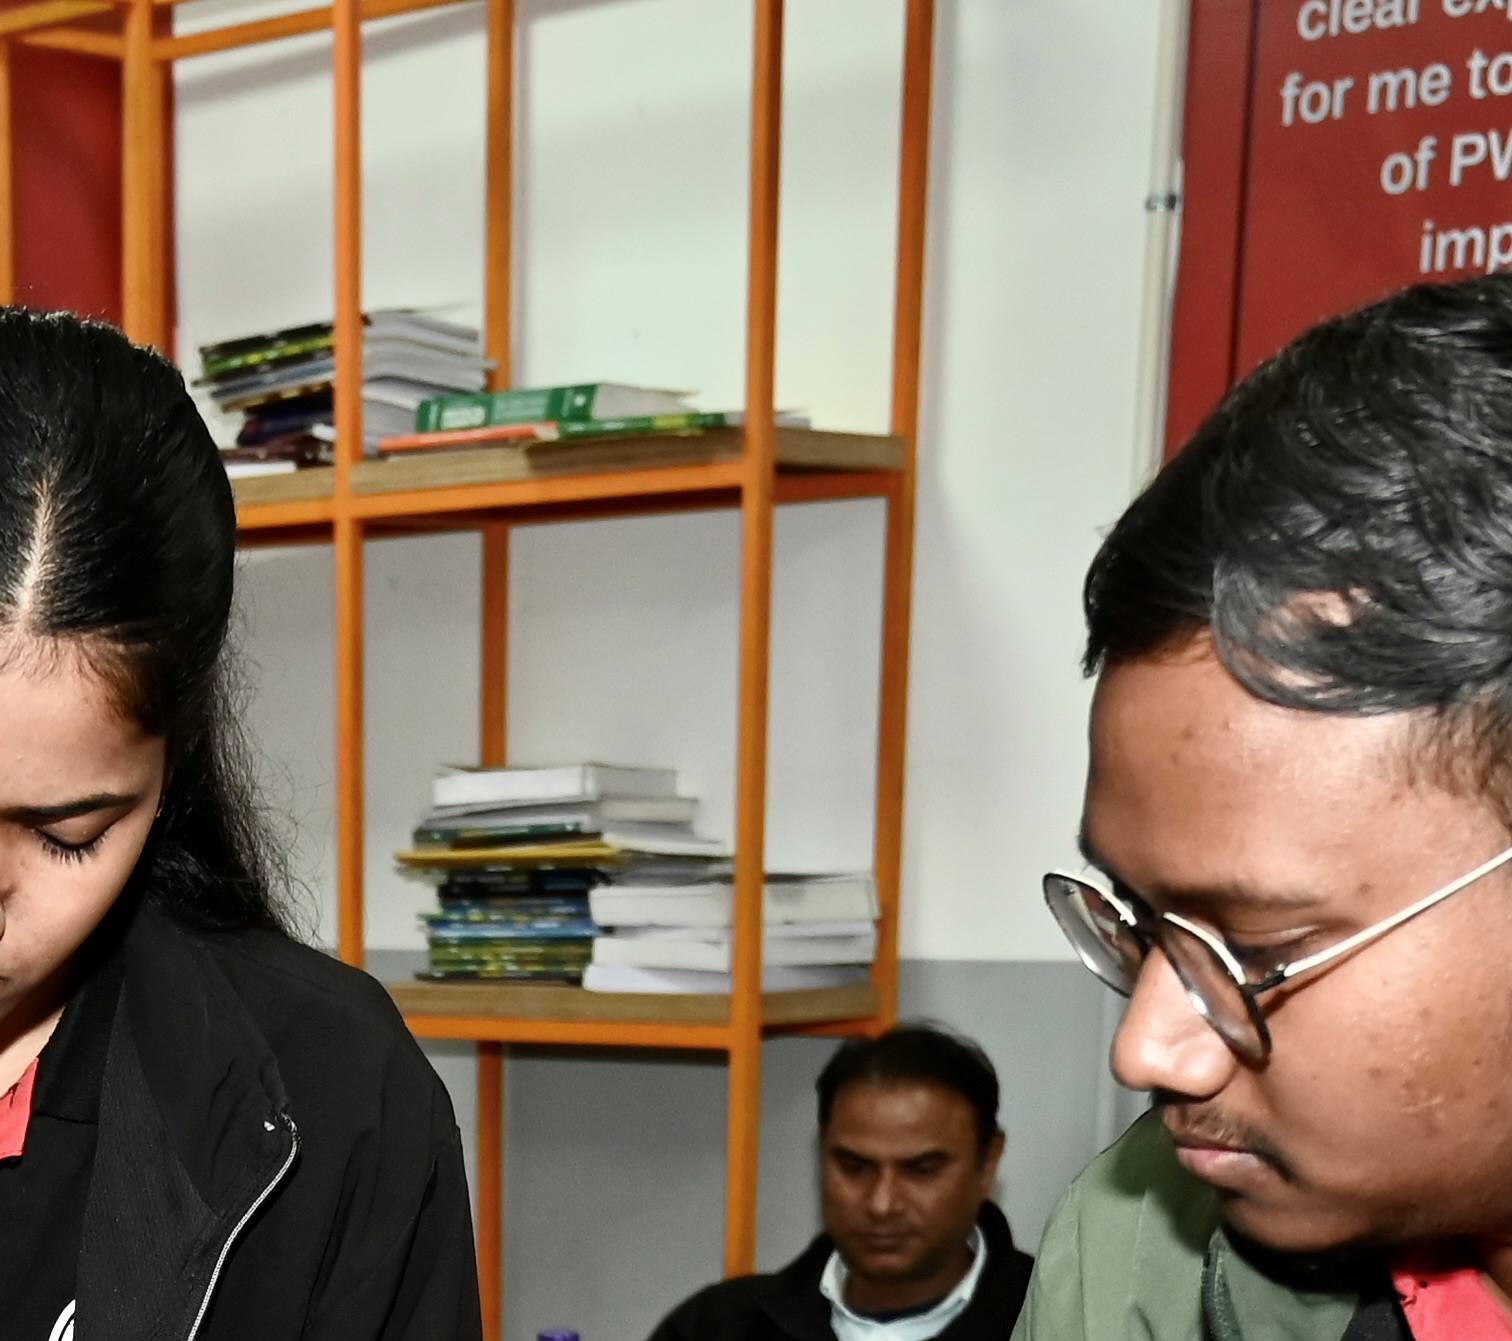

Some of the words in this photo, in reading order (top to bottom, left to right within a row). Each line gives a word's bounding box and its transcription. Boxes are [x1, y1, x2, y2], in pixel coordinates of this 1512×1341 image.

[1281, 72, 1354, 126] for
[1368, 64, 1451, 113] me
[1381, 136, 1437, 194] of
